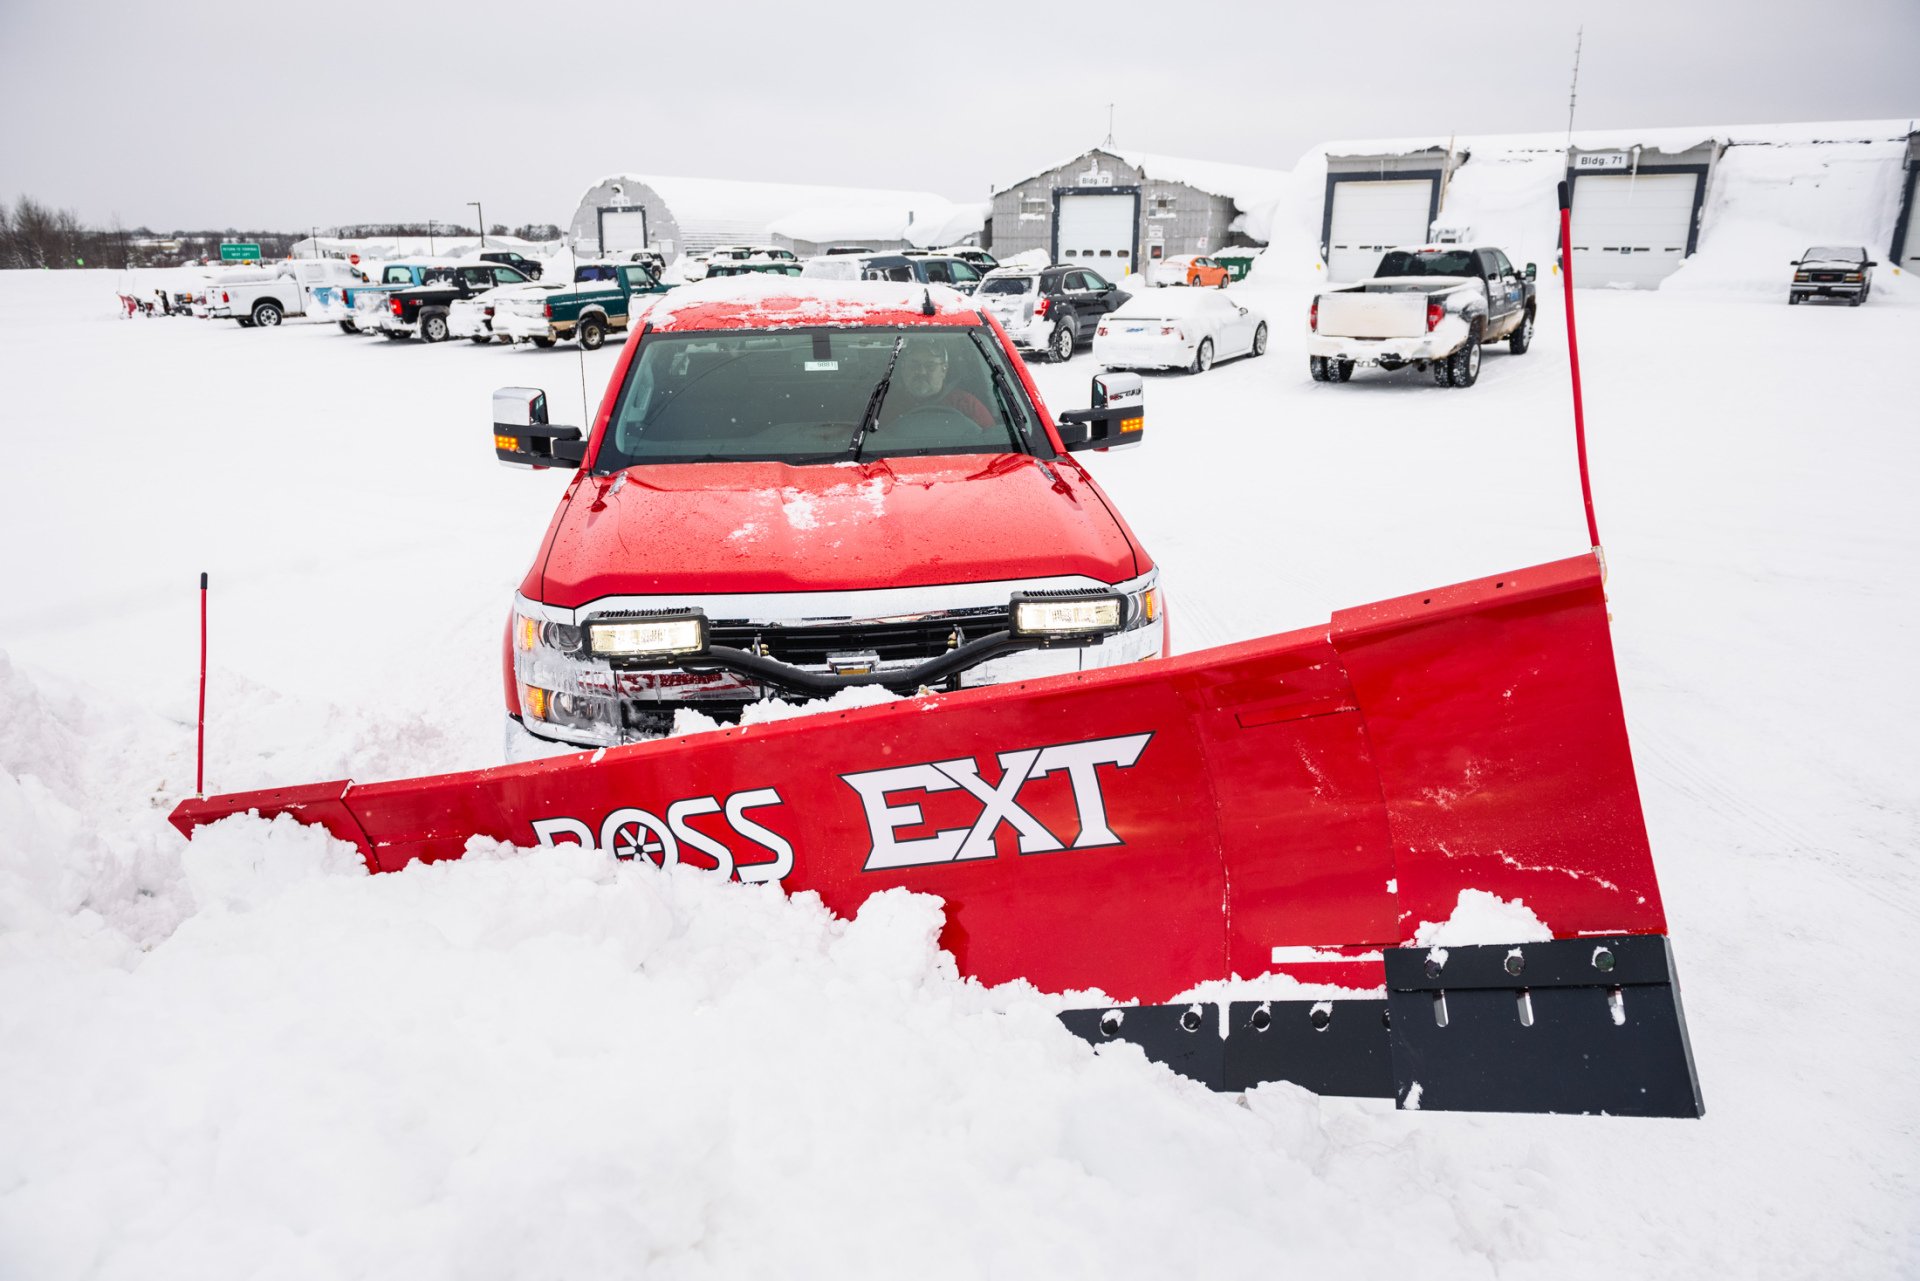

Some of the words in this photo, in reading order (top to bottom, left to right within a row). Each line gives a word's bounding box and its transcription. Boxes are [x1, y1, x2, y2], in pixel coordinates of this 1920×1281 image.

[1581, 156, 1608, 166] Bldg.
[1611, 156, 1623, 164] 71
[1102, 176, 1109, 184] 72
[837, 730, 1157, 873] EXT
